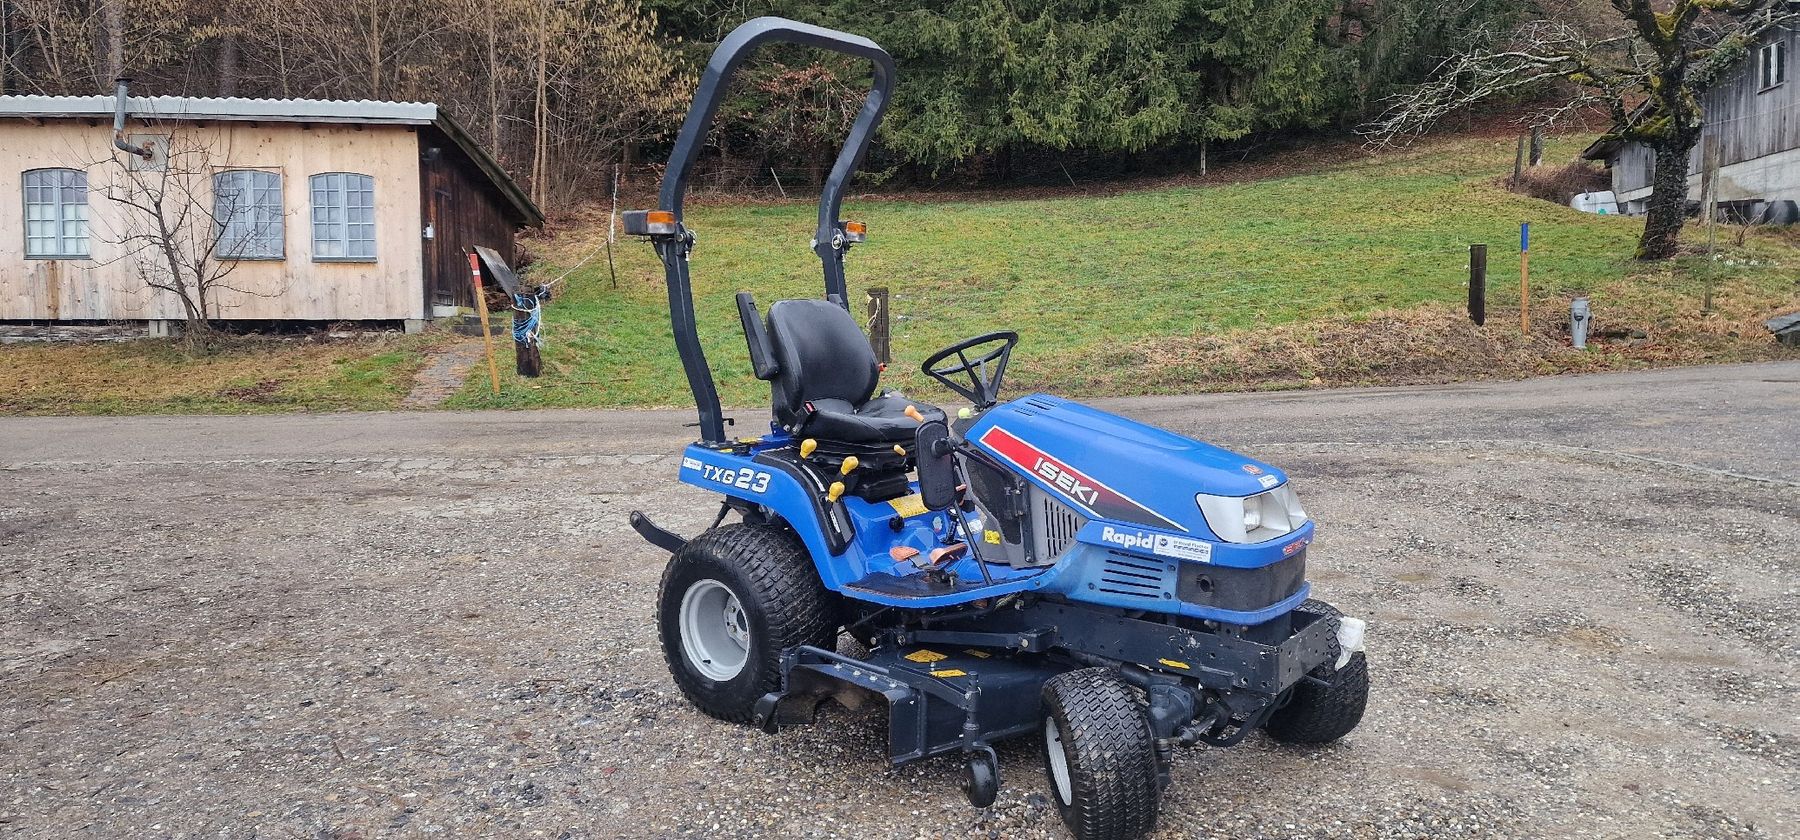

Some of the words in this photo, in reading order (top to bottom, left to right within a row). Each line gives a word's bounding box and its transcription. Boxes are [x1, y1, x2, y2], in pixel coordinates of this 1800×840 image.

[703, 464, 736, 485] TXG
[735, 467, 771, 493] 23
[1034, 457, 1099, 506] ISEKI
[1102, 526, 1154, 549] Rapid
